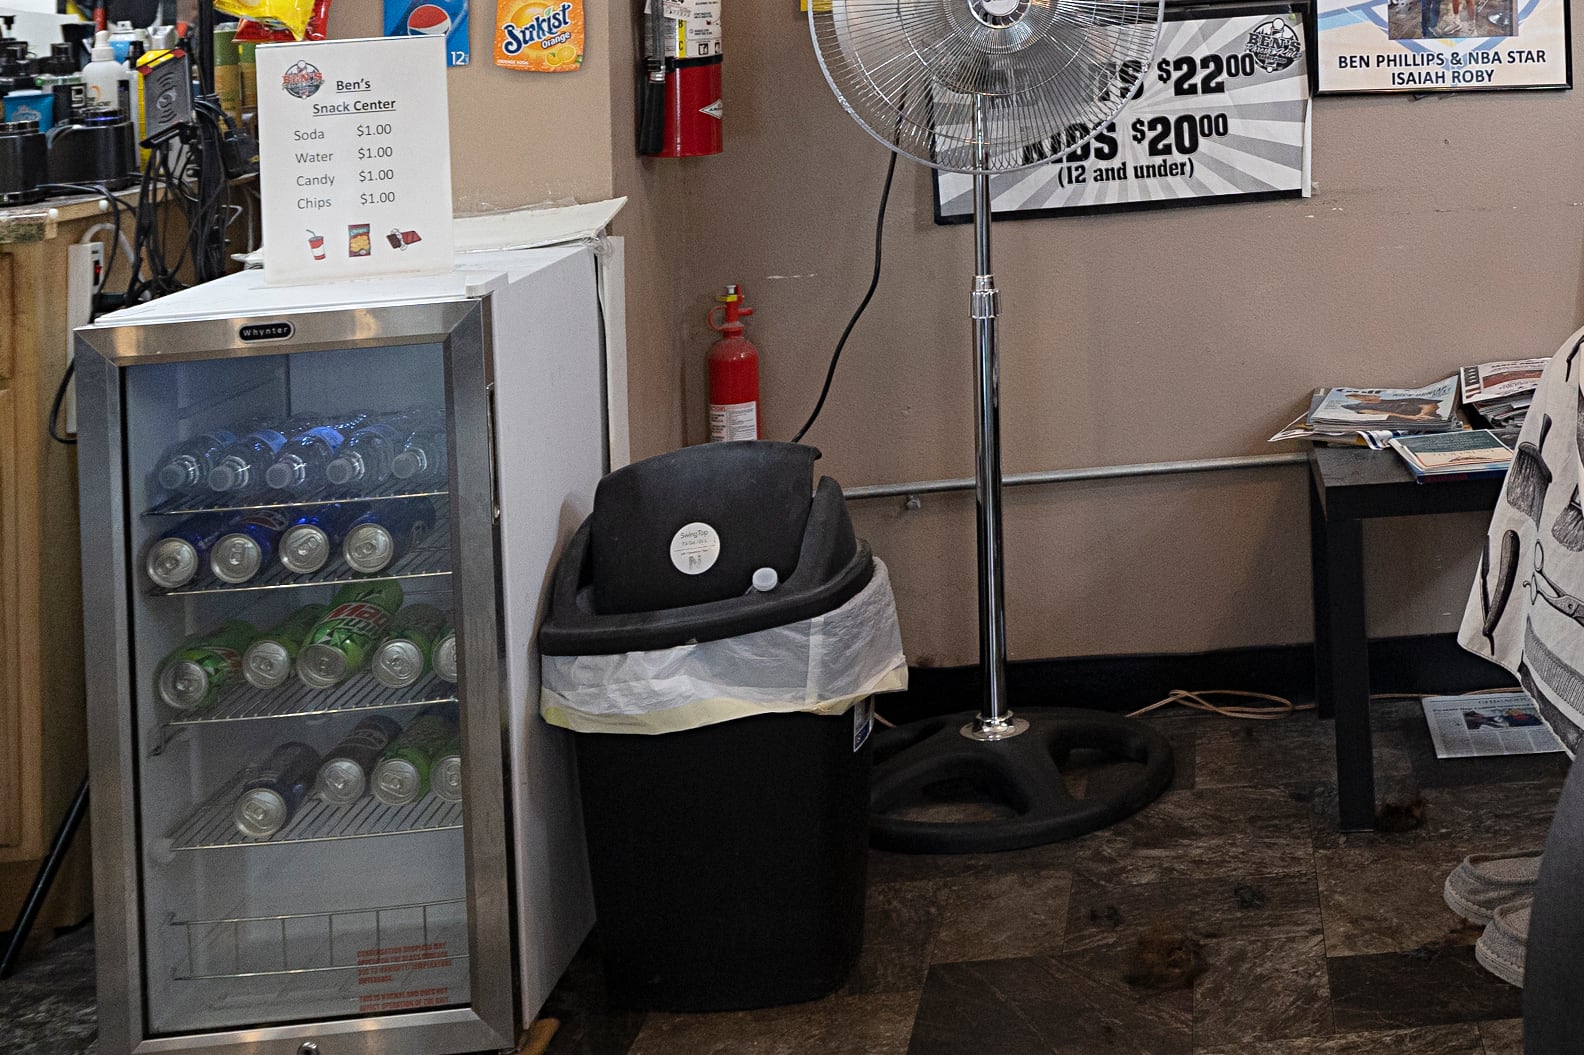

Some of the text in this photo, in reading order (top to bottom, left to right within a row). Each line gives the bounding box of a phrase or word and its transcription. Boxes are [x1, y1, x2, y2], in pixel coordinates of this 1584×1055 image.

[501, 0, 572, 57] Sunkist
[541, 29, 572, 50] Orange
[1247, 31, 1301, 49] BEN'S
[450, 51, 465, 66] 12
[1338, 48, 1547, 70] BEN PHILLIPS & NBA STAR
[281, 70, 324, 85] BEN'S
[335, 77, 371, 92] Ben's
[1390, 69, 1496, 87] ISAIAH ROBY
[312, 98, 397, 115] Snack Center
[293, 122, 392, 141] Soda $1.00
[295, 145, 393, 164] Water $1.00
[296, 168, 395, 188] Candy $1.00
[1057, 155, 1196, 189] (12 and under)
[297, 190, 396, 211] Chips $1.00
[242, 325, 290, 339] Whynter
